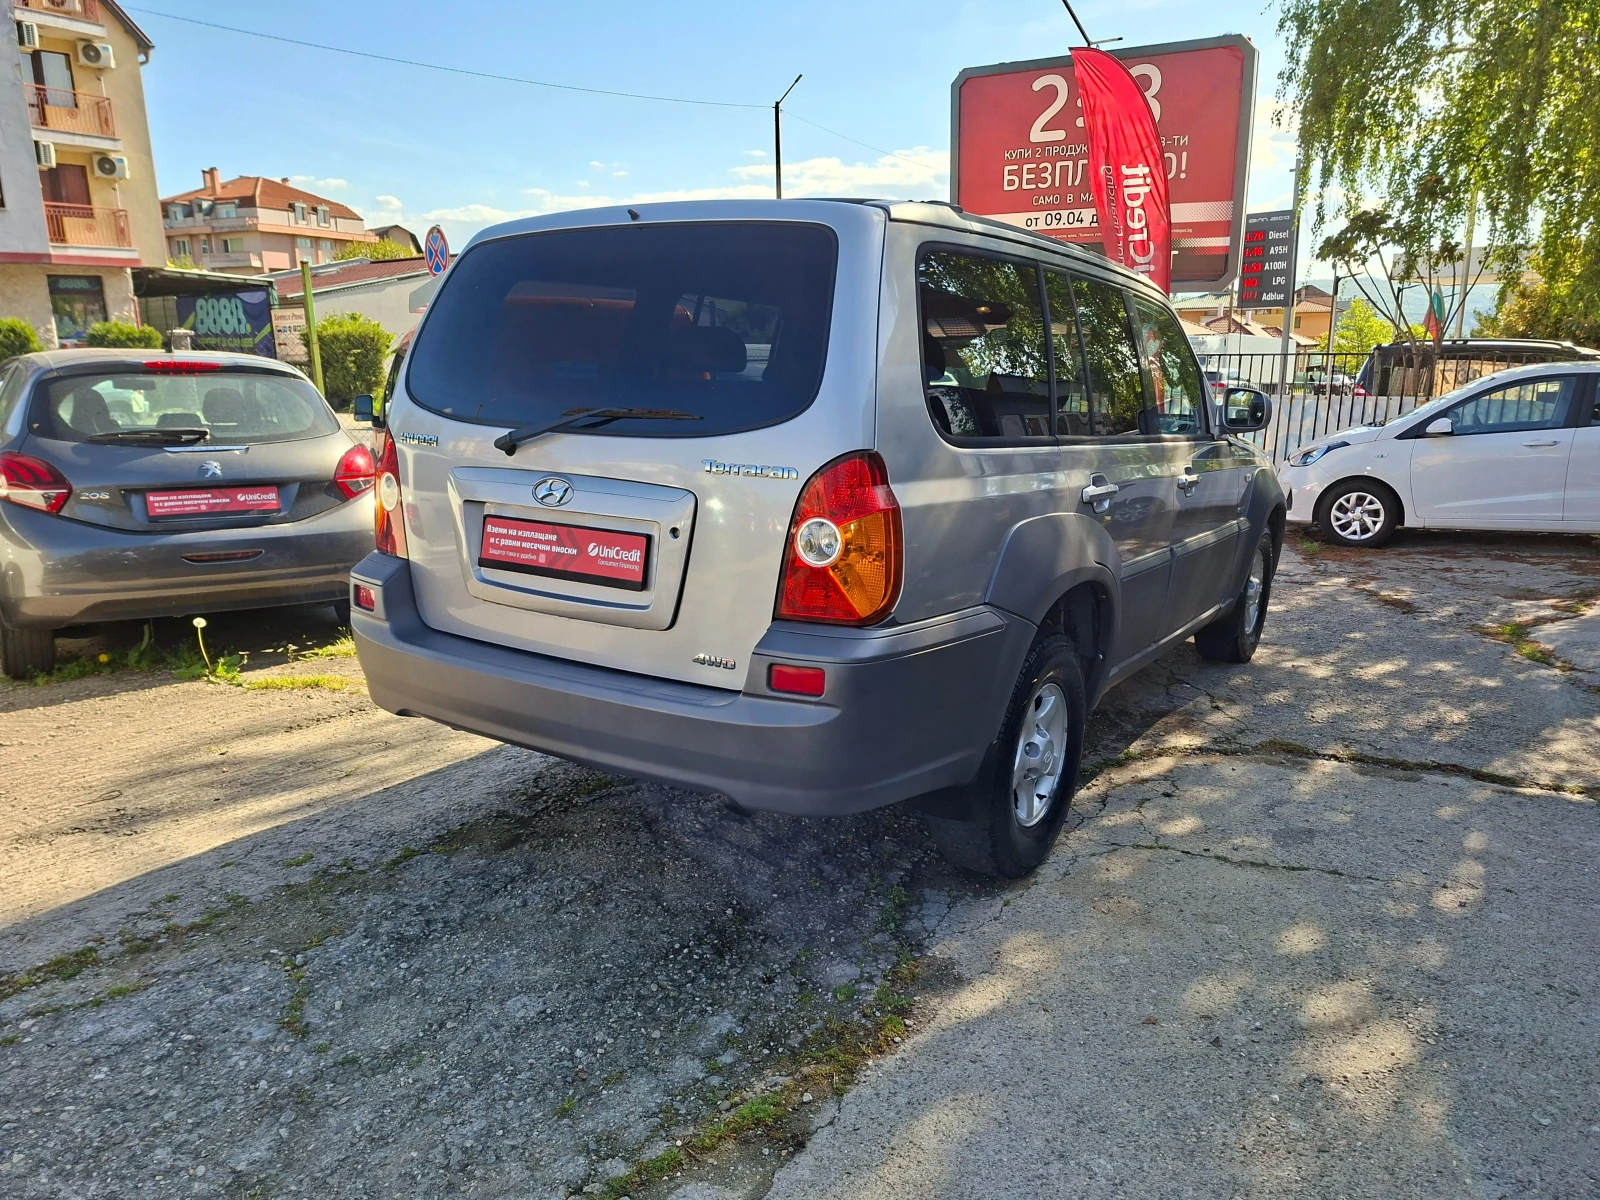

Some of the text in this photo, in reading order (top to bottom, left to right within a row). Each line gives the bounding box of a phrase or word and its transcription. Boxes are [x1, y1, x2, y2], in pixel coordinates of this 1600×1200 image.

[1004, 148, 1032, 160] КУПИ
[1035, 147, 1041, 158] 2
[1045, 144, 1089, 157] ПРОДУК
[1032, 194, 1060, 206] САМО
[1066, 193, 1074, 203] В
[1025, 217, 1040, 228] от
[1044, 211, 1085, 227] 09.04
[1268, 230, 1289, 240] Diesel
[1269, 246, 1288, 255] A95H
[1264, 261, 1287, 271] A100H
[1272, 277, 1286, 286] LPG
[1261, 292, 1285, 301] Adblue
[701, 459, 799, 480] Terracan
[80, 492, 110, 500] 208
[245, 492, 276, 500] UniCredit
[486, 524, 557, 542] Вземи на изплащане
[489, 536, 577, 555] и с равни месечни вноски
[598, 545, 641, 563] UniCredit
[692, 653, 736, 670] 4WD
